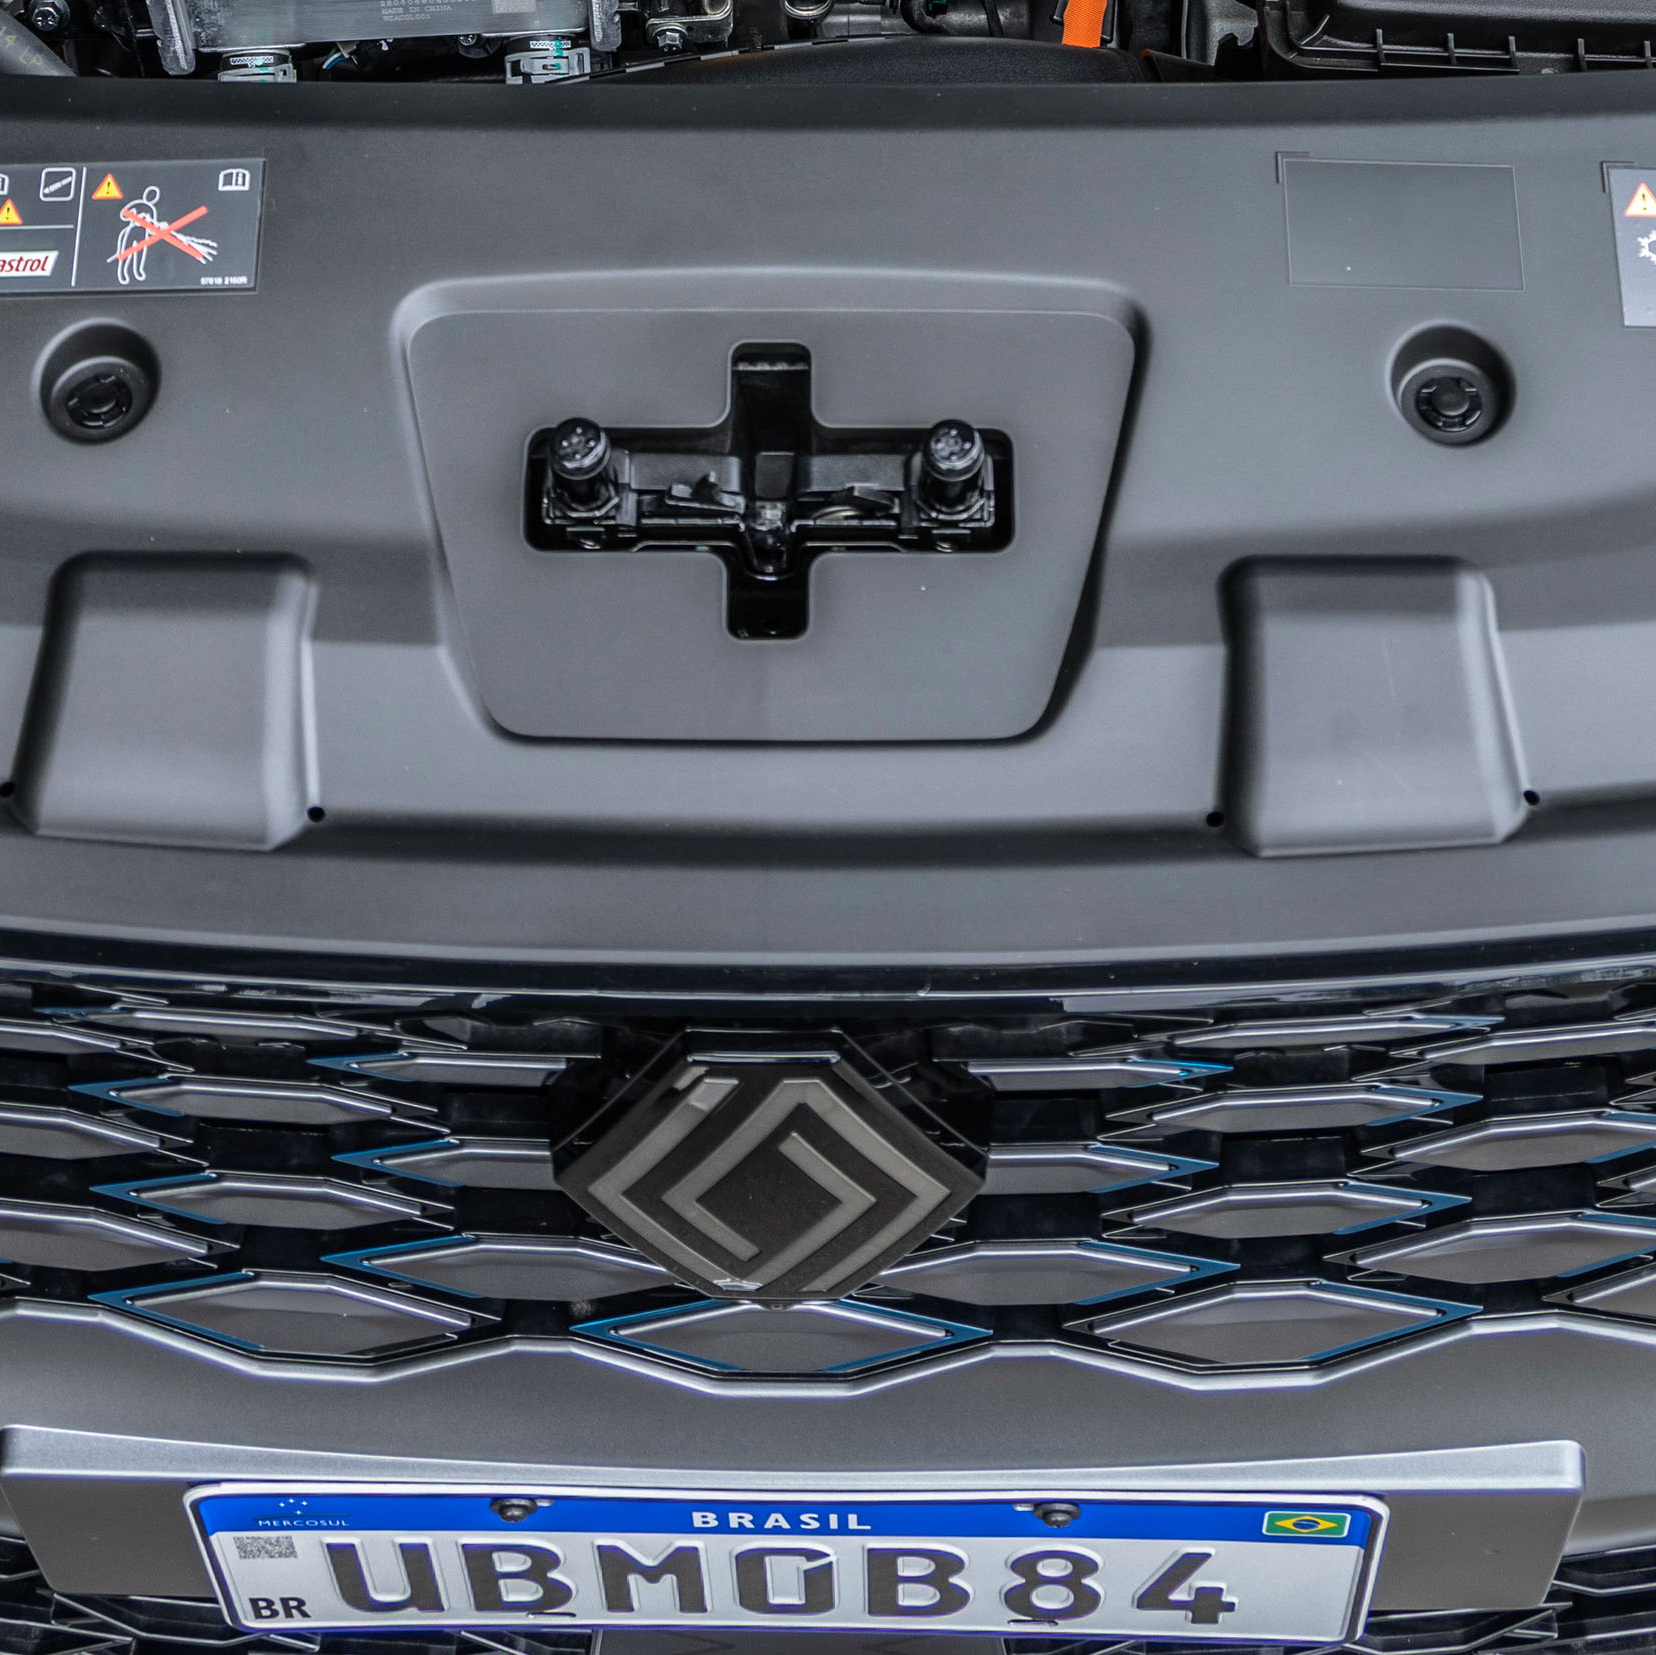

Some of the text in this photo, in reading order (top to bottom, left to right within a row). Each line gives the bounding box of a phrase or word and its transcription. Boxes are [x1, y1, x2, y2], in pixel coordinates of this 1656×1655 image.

[257, 1519, 350, 1527] MERCOSUL
[691, 1510, 873, 1531] BRASIL
[249, 1596, 312, 1620] BR
